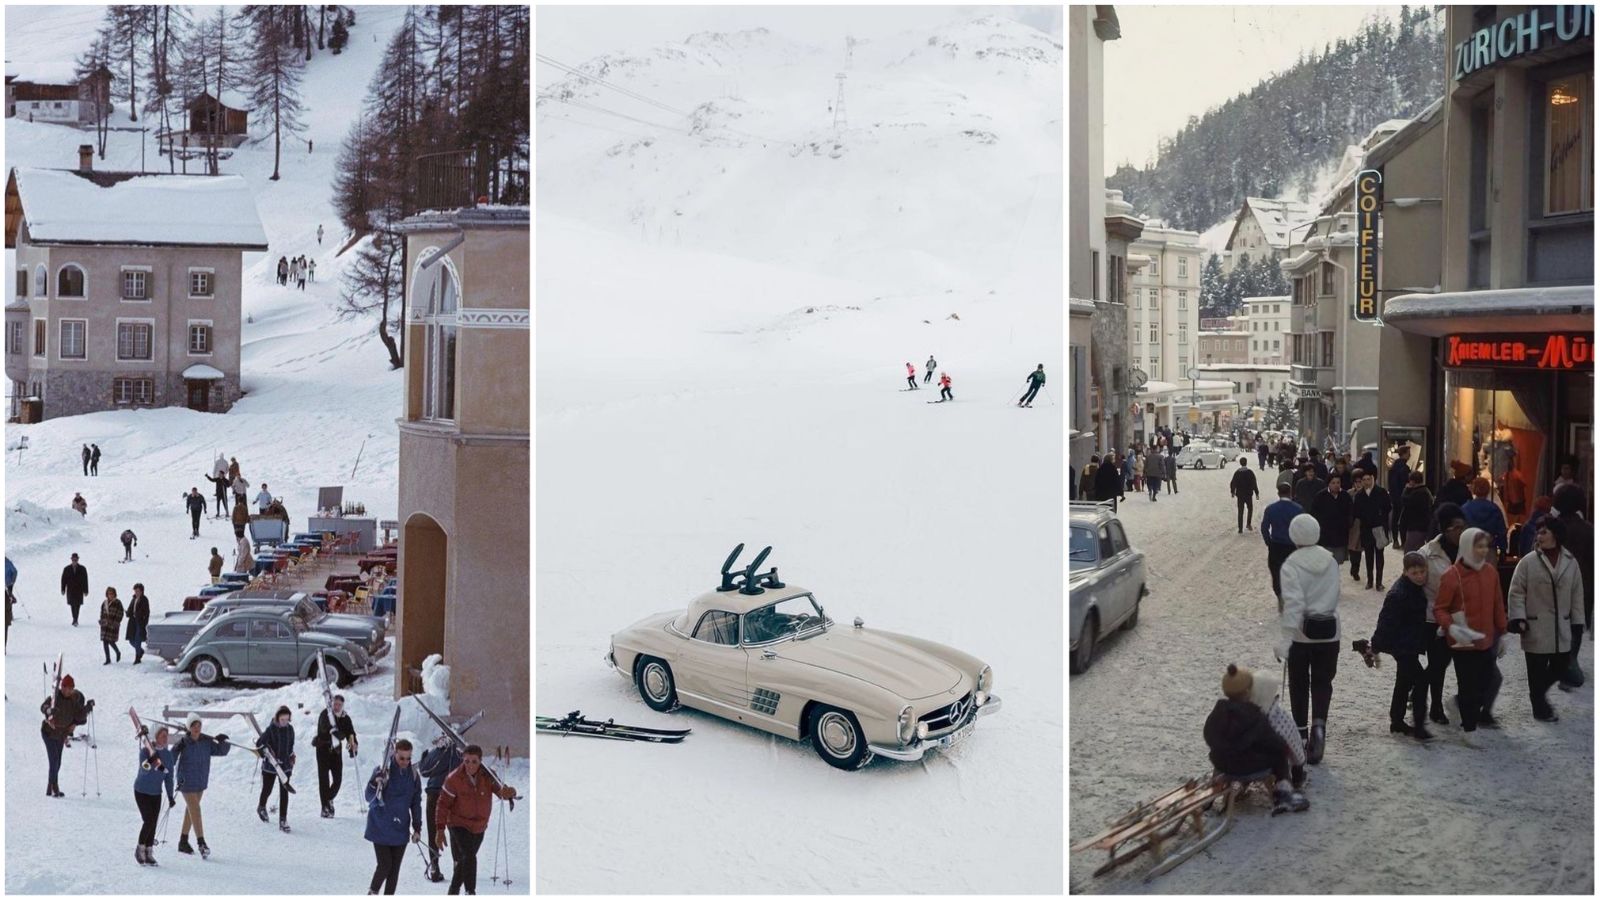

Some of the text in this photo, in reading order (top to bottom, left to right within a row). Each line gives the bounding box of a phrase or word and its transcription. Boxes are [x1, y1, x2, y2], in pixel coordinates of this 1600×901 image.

[1360, 177, 1377, 314] COIFFEUR
[1449, 335, 1594, 368] KRIEMLER-MÜ
[1302, 389, 1322, 397] BANK
